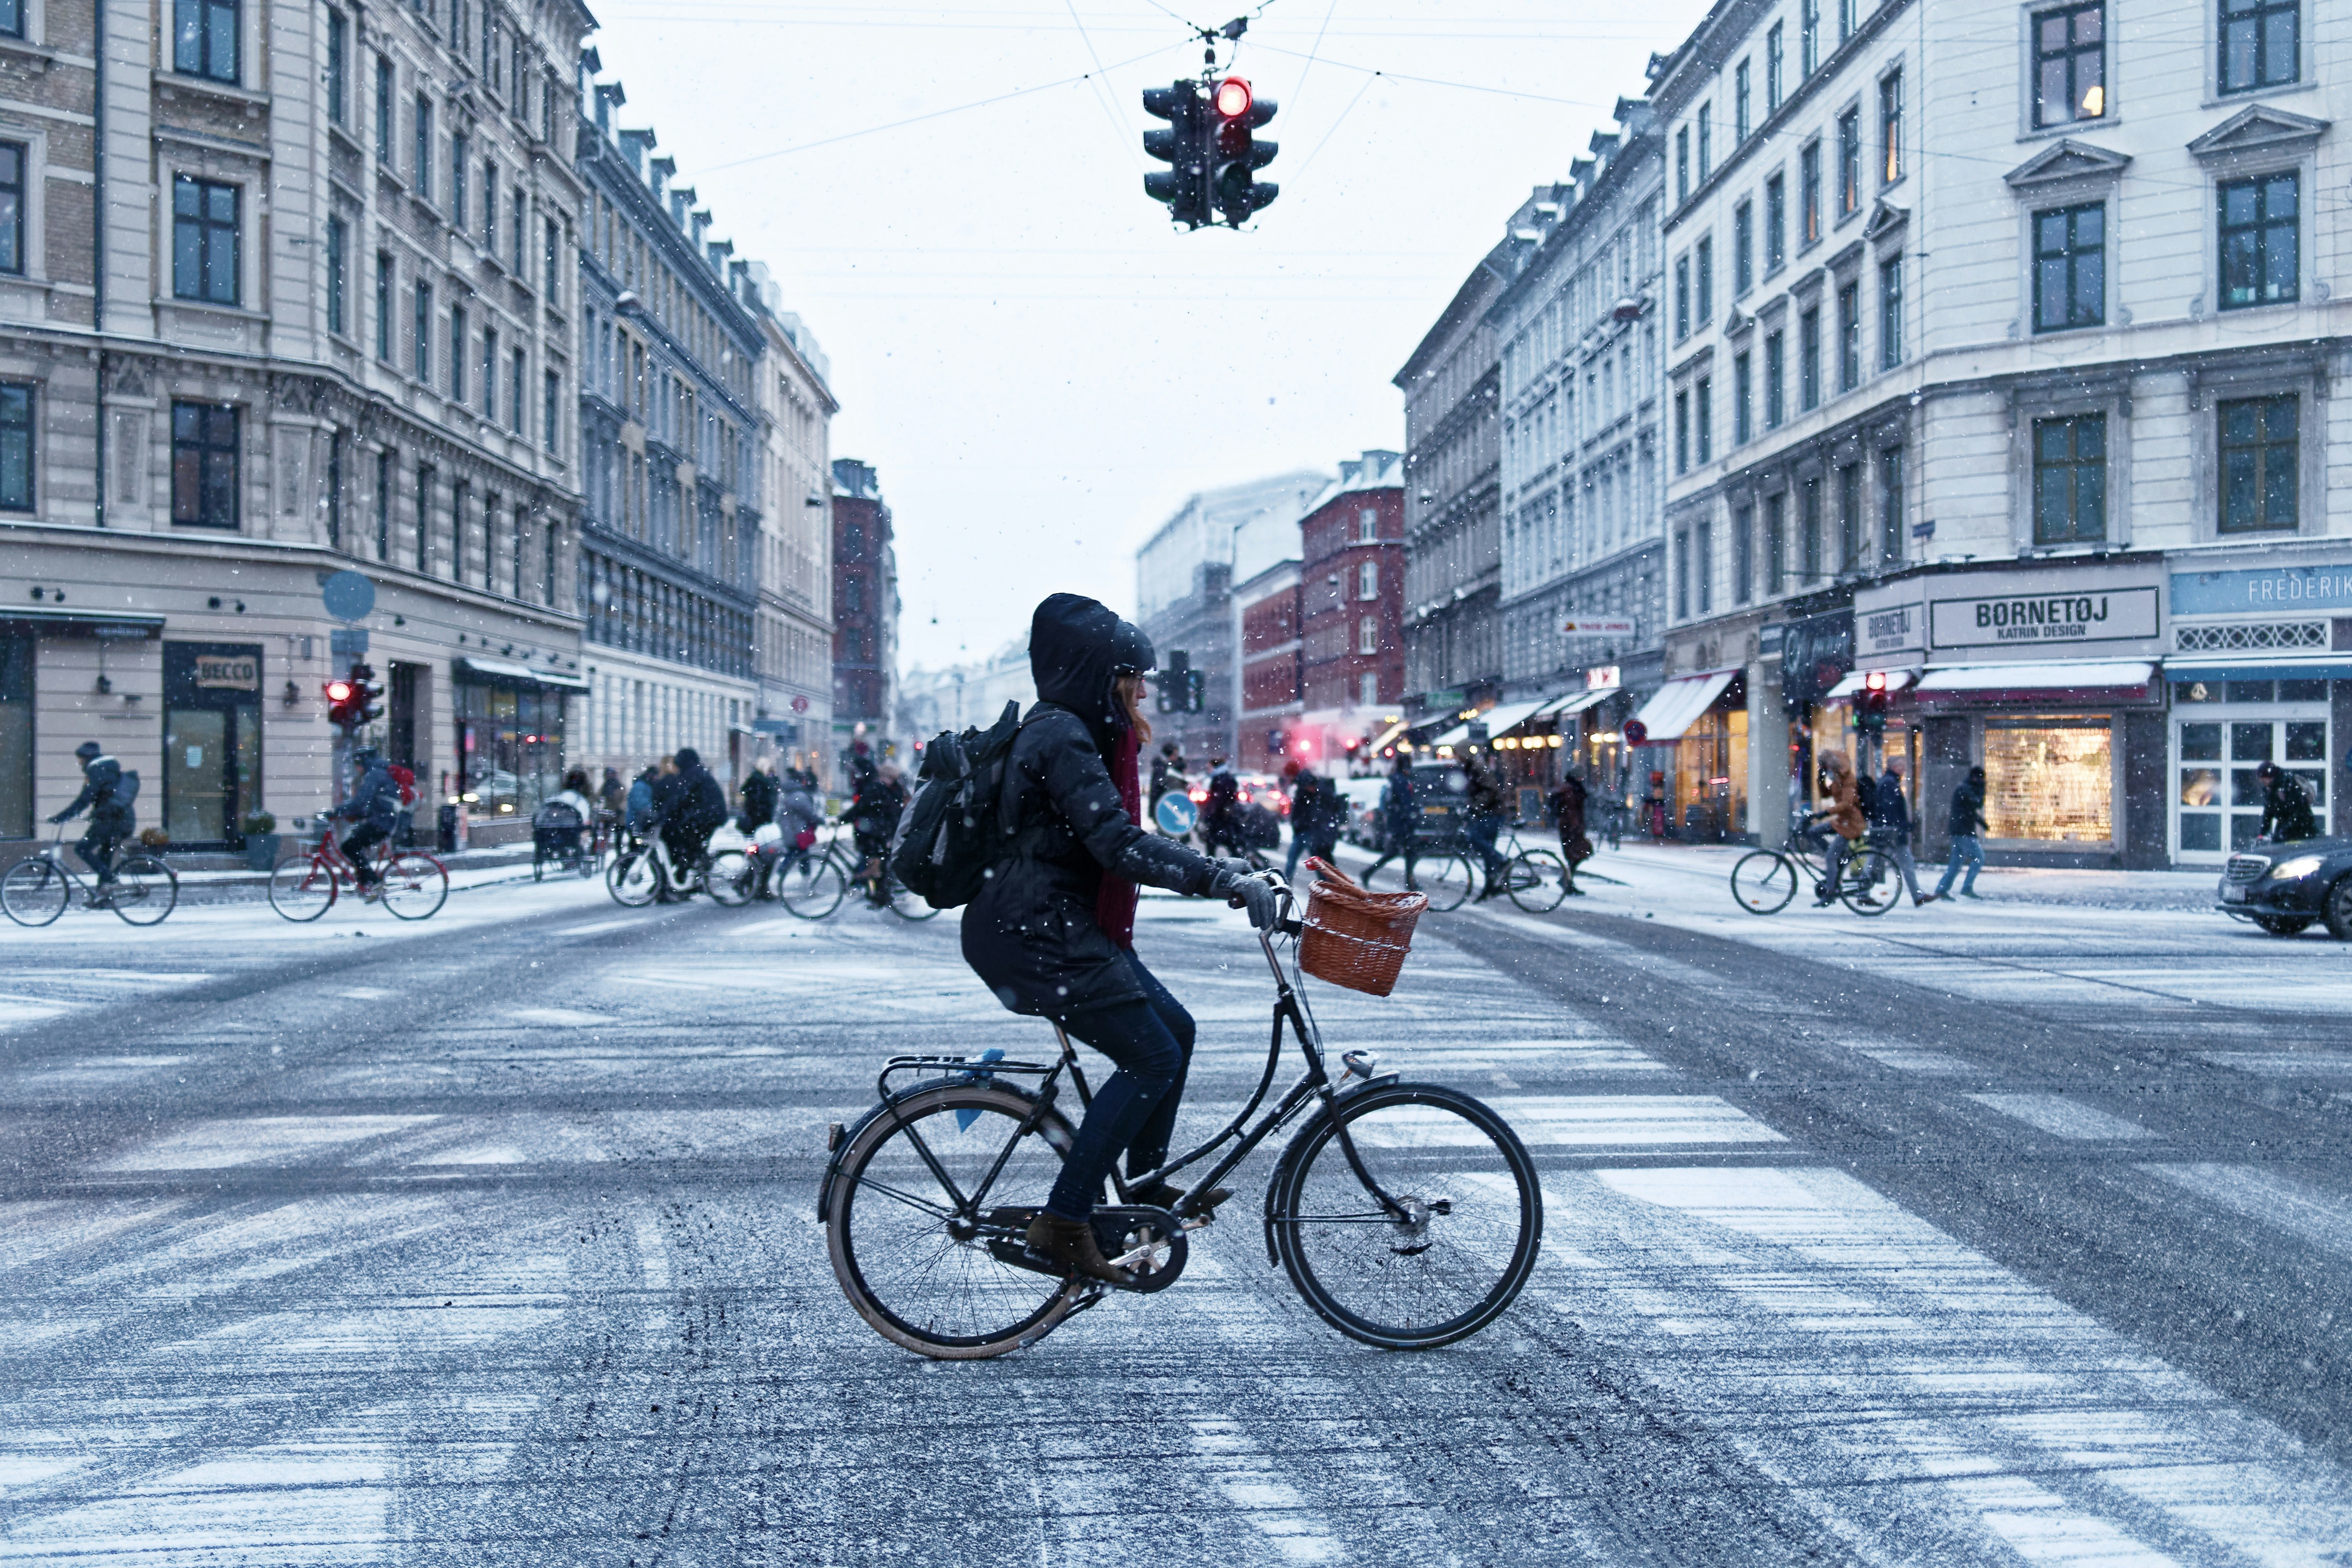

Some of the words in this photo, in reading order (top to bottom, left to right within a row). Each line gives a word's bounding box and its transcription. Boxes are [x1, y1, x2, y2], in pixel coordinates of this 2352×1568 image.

[2249, 575, 2352, 602] FREDERIK
[1998, 626, 2039, 639] KATRIN
[2043, 624, 2086, 638] DESIGN
[201, 662, 253, 680] BECCO
